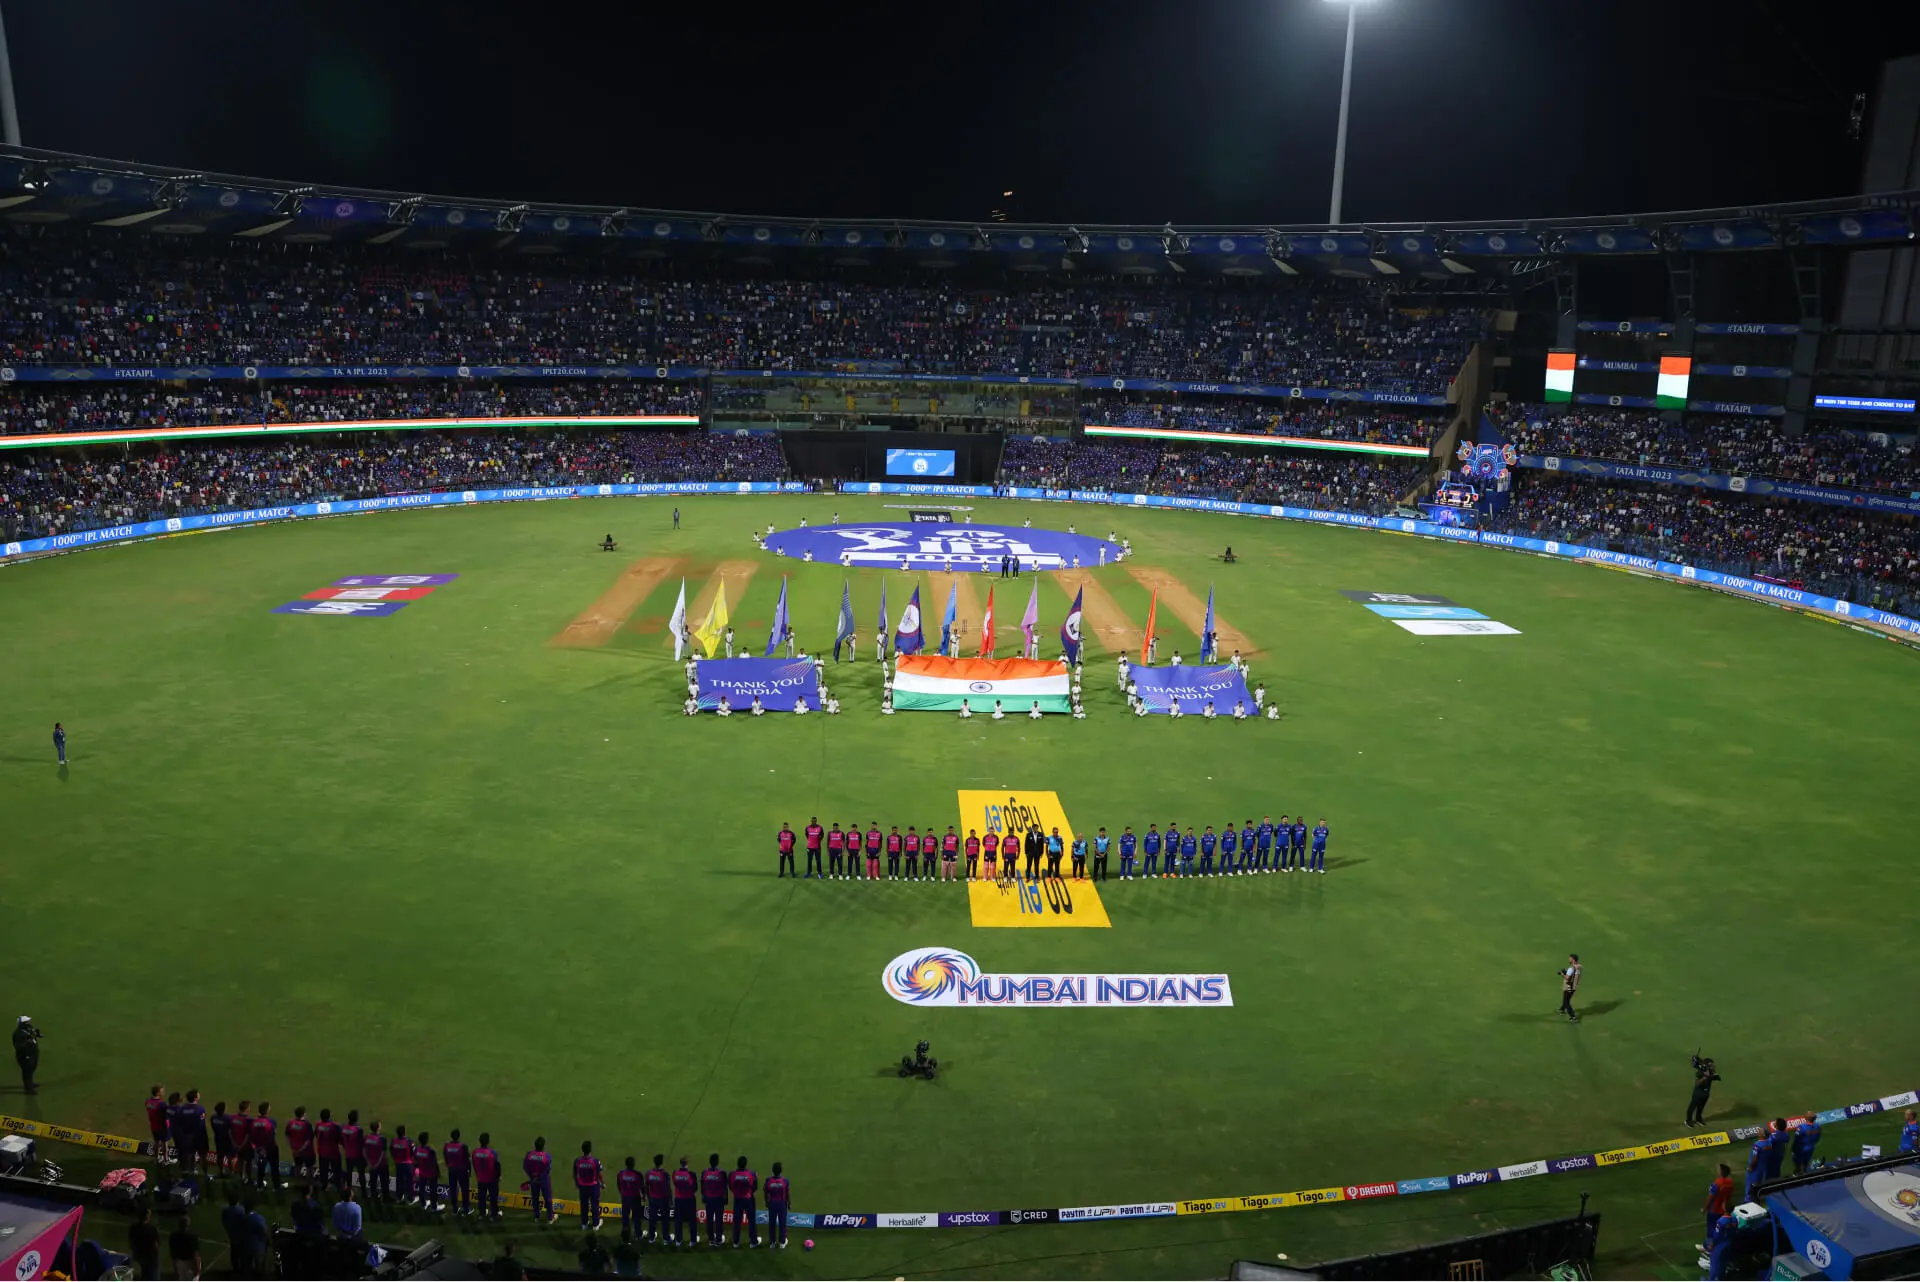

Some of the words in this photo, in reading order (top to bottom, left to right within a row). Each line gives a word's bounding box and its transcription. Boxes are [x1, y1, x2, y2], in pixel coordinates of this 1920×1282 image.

[1727, 324, 1766, 334] #TATAIPL
[1603, 361, 1638, 370] MUMBAI
[115, 369, 154, 378] #TATAIPL
[1374, 394, 1418, 403] IPLT20.COM
[1714, 404, 1752, 414] #TATAIPL
[1615, 466, 1634, 476] TATA
[1636, 468, 1649, 478] IPL
[1651, 470, 1672, 480] 2023
[665, 483, 678, 491] IPL
[679, 483, 708, 491] MATCH
[387, 498, 399, 506] IPL
[402, 495, 431, 505] MATCH
[1199, 500, 1210, 508] IPL
[1212, 501, 1240, 511] MATCH
[243, 510, 256, 520] IPL
[1336, 513, 1348, 522] IPL
[1350, 515, 1379, 526] MATH
[84, 531, 97, 542] IPL
[100, 526, 133, 540] MATCH
[1483, 533, 1514, 545] MATCH
[918, 541, 1060, 556] IPL
[1614, 553, 1626, 562] IPL
[1753, 582, 1766, 593] IPL
[1768, 584, 1802, 602] MATCH
[710, 679, 766, 688] THANK
[771, 676, 804, 687] YOU
[1143, 684, 1199, 694] THANK
[1200, 681, 1233, 691] YOU
[1169, 692, 1214, 700] INDIA
[958, 976, 1088, 1004] MUMBAI
[1096, 976, 1224, 1004] INDIANS
[1850, 1102, 1874, 1115] RuPay
[1, 1117, 36, 1132] Tiago.ev
[49, 1126, 83, 1141] Tiago.ev
[95, 1134, 131, 1149] Tiago.ev
[1689, 1136, 1724, 1146] Tiago.ev
[1645, 1143, 1680, 1155] Tiago.ev
[1601, 1151, 1636, 1163] Tiago.ev
[1556, 1156, 1589, 1171] upstox
[1456, 1172, 1488, 1185] RuPay
[1509, 1167, 1537, 1178] Herbalife
[1360, 1184, 1395, 1196] DREAM11
[1240, 1197, 1283, 1209] Tiago.ev
[1296, 1191, 1338, 1203] Tiago.ev
[1094, 1208, 1112, 1216] UPI
[1152, 1205, 1171, 1214] UPI
[1183, 1201, 1227, 1213] Tiago.ev
[824, 1214, 862, 1227] RuPay
[888, 1217, 924, 1226] Herbalife
[949, 1212, 990, 1226] upstox
[1023, 1212, 1048, 1220] CRED
